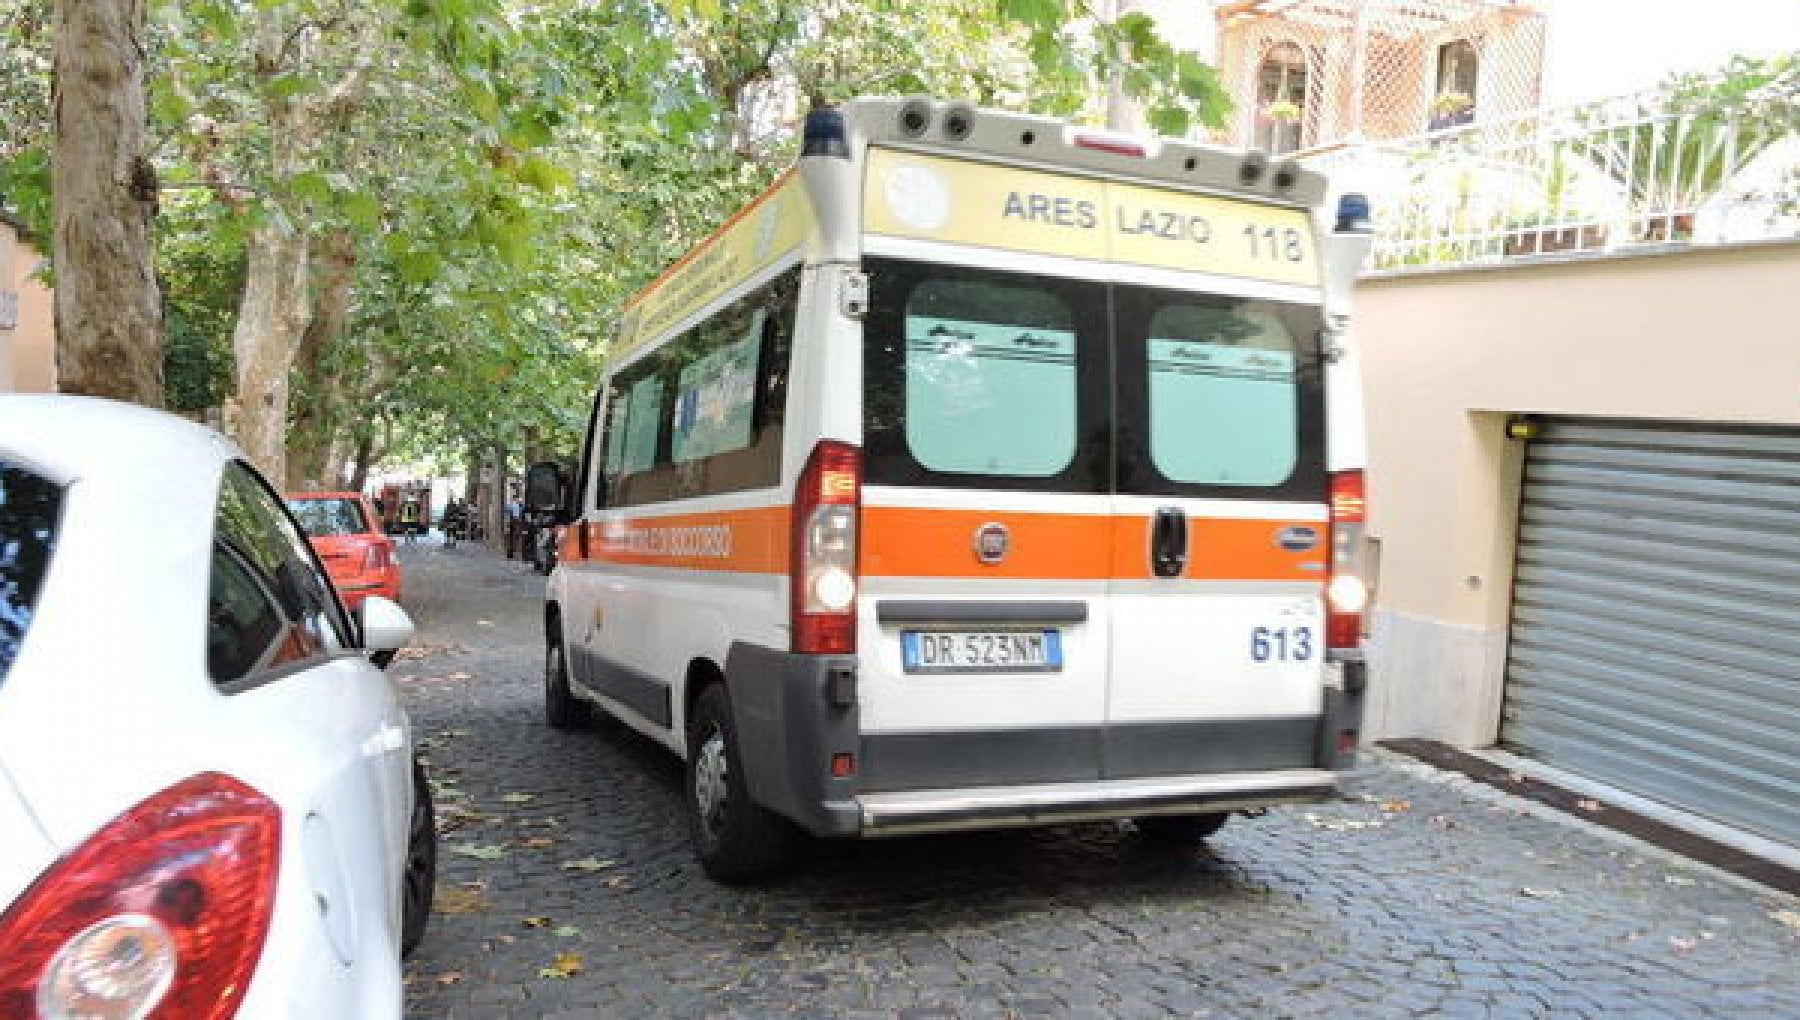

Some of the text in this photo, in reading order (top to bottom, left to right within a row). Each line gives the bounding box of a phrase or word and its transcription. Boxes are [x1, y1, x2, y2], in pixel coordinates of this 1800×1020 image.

[1002, 191, 1303, 262] ARES LAZIO 118
[922, 635, 954, 664] DR
[1249, 626, 1313, 662] 613
